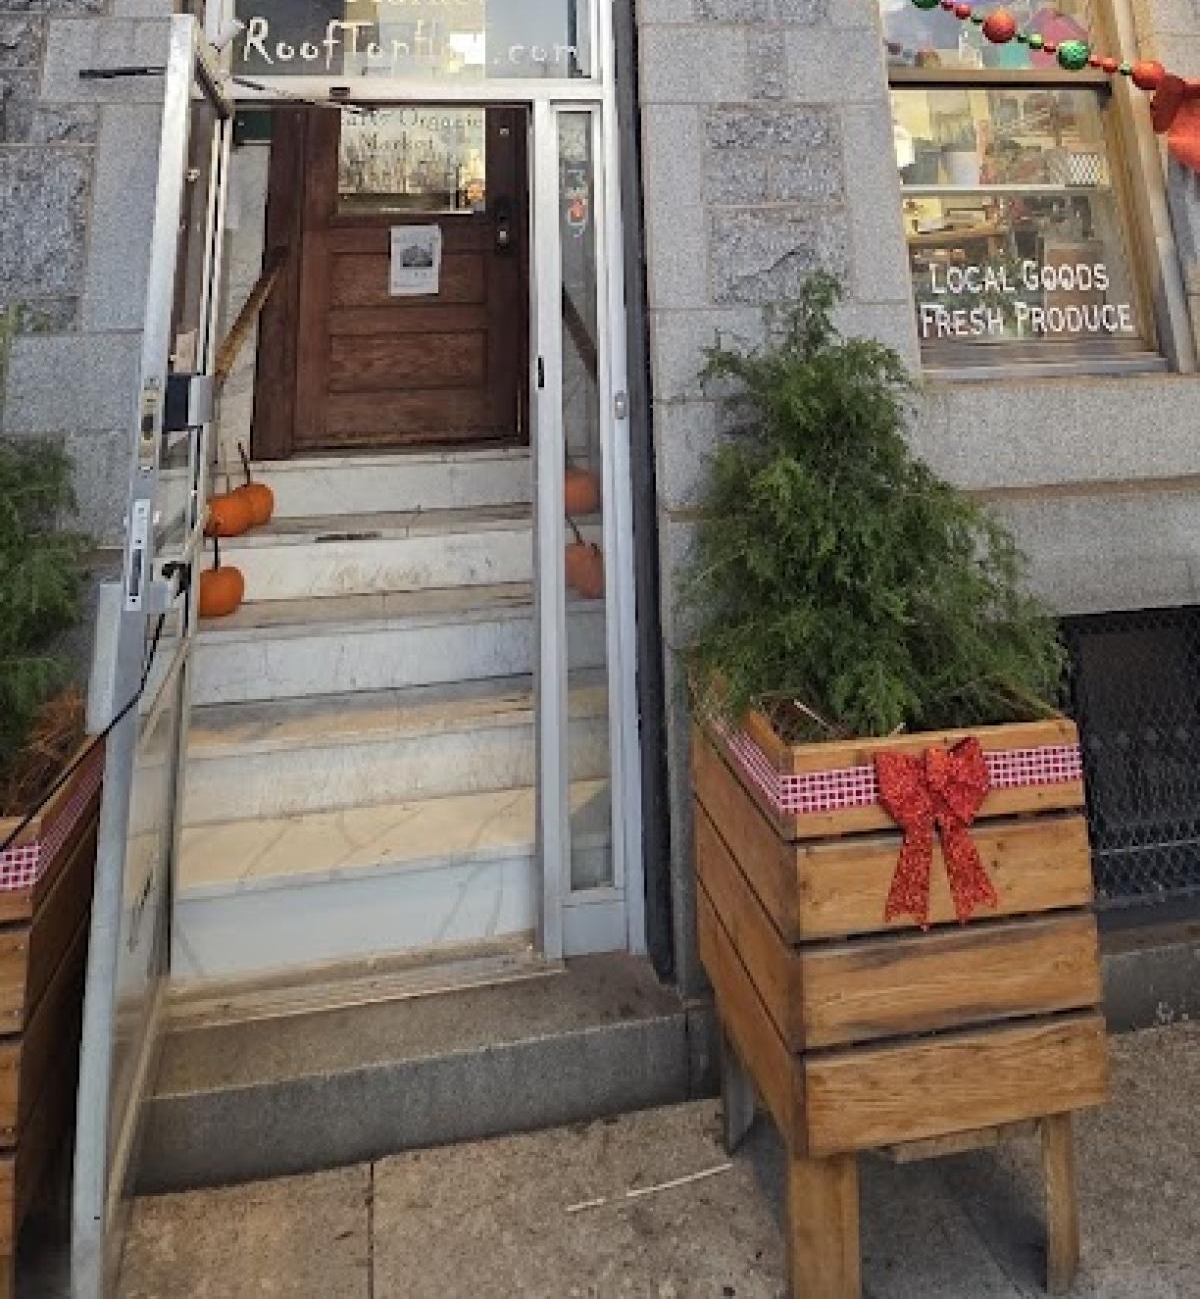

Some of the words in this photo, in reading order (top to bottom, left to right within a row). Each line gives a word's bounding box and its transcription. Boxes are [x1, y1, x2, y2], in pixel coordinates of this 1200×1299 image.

[243, 16, 581, 71] RoofTopH.com
[928, 262, 1016, 294] LOCAL
[1022, 259, 1111, 292] GOODS
[920, 304, 1004, 339] FRESH
[1013, 300, 1136, 337] PRODUCE
